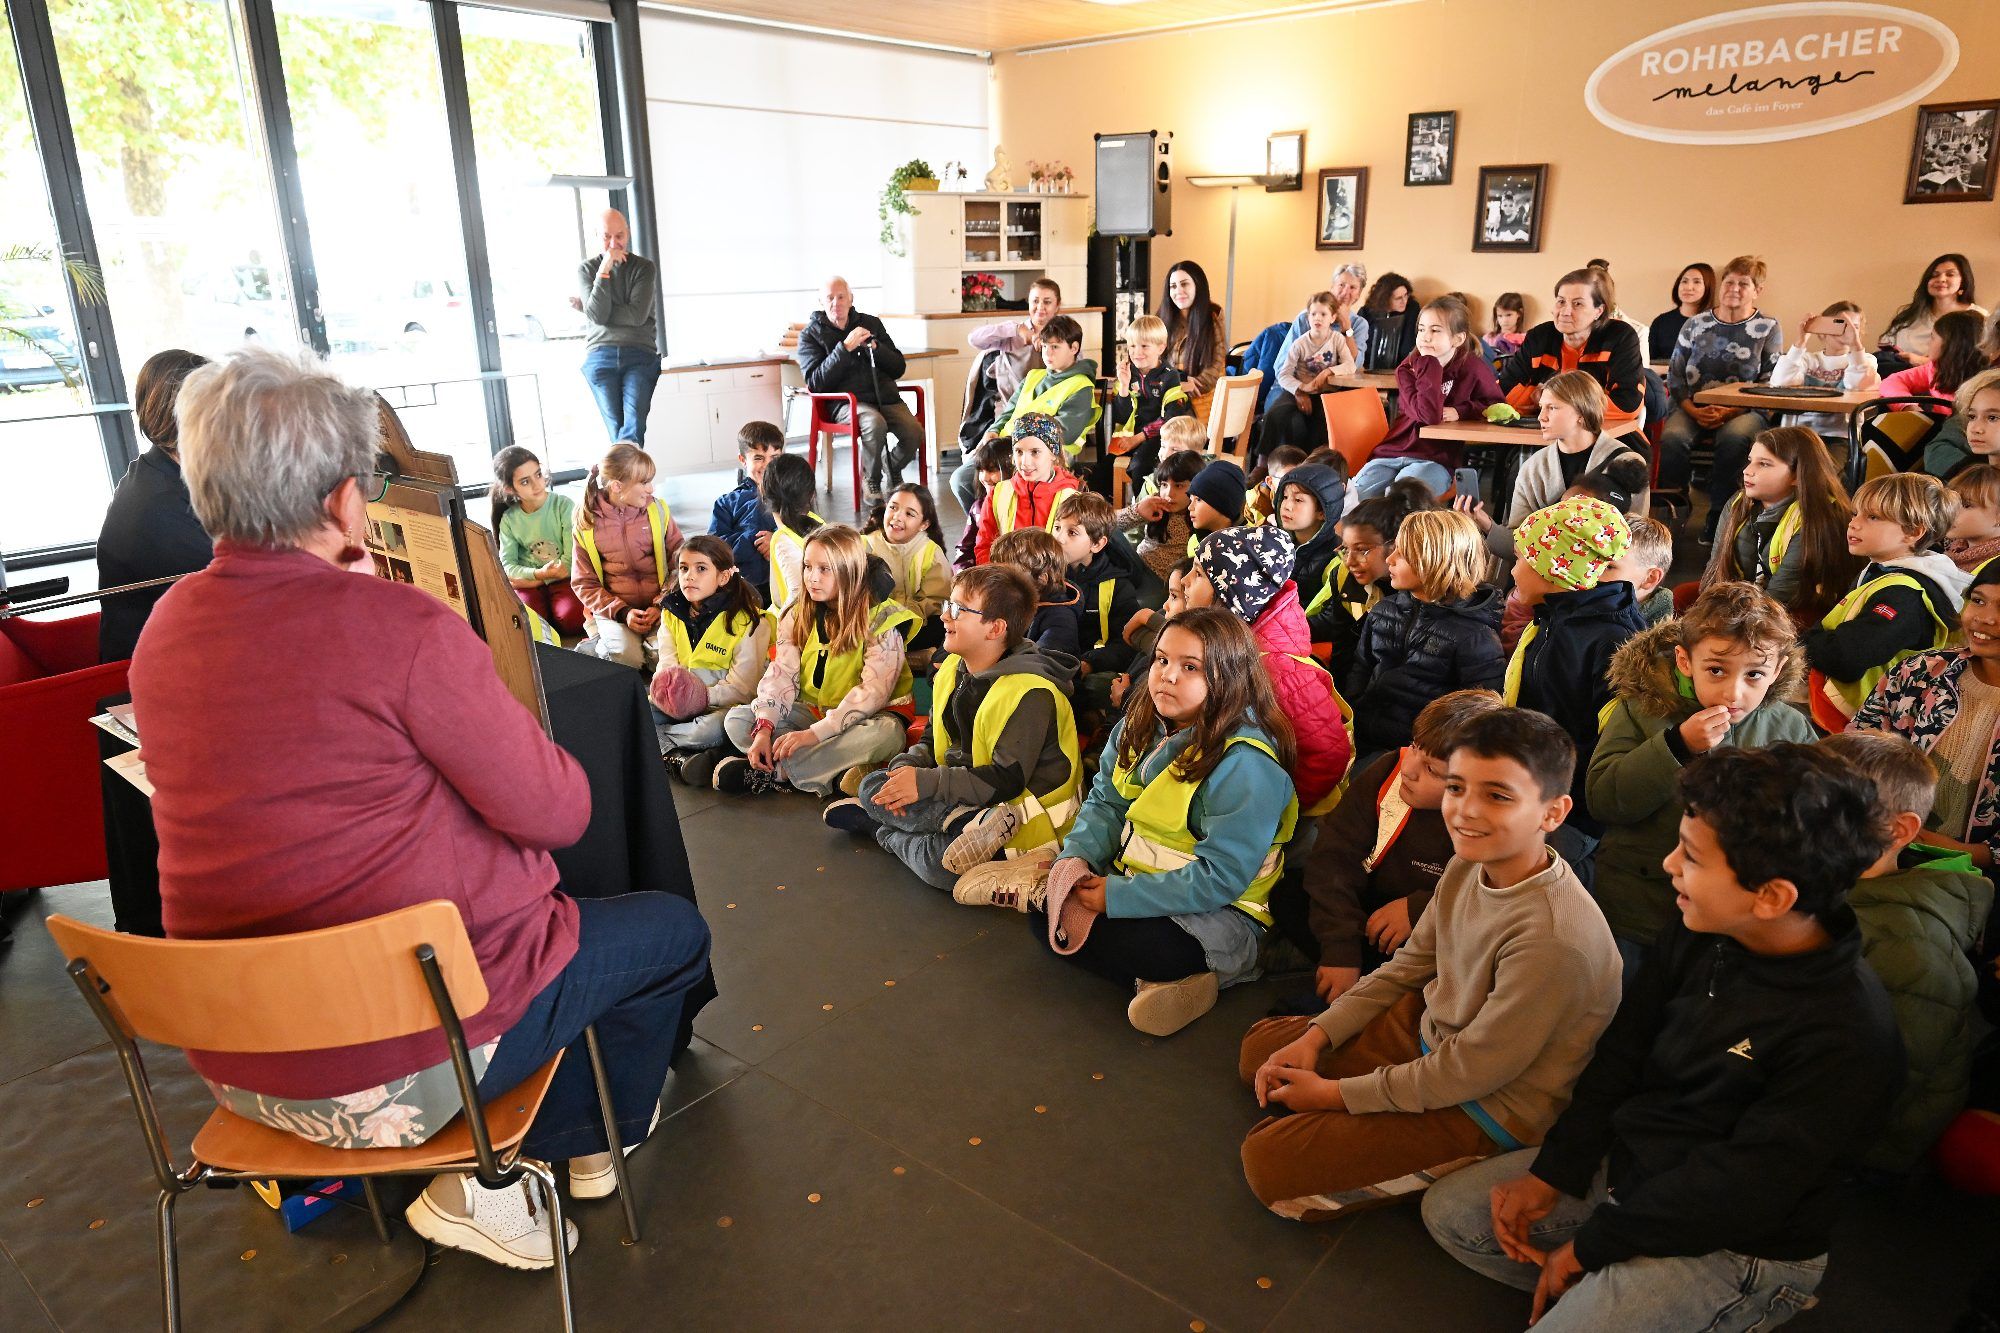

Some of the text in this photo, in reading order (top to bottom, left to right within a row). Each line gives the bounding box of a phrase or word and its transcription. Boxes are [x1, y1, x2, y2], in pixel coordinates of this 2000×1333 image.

[1641, 26, 1903, 76] ROHRBACHER
[1652, 71, 1875, 101] melange
[1705, 101, 1804, 116] das Café im Foyer
